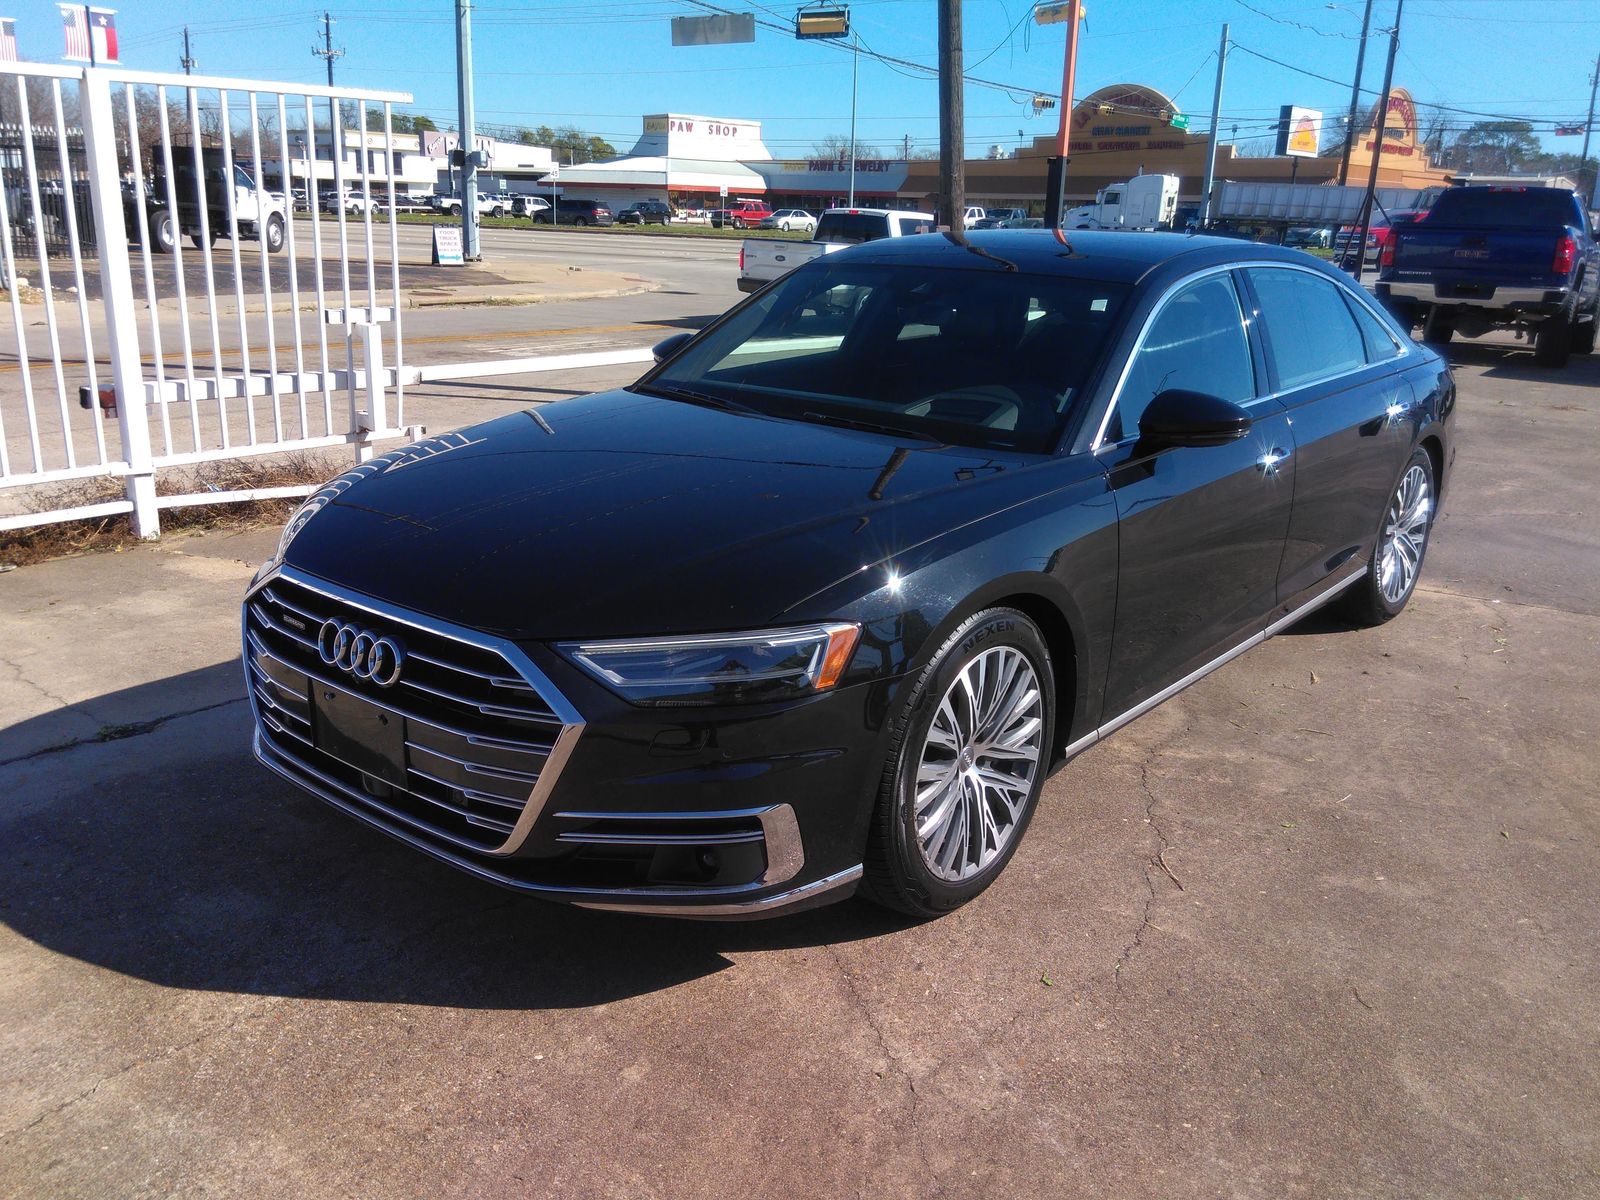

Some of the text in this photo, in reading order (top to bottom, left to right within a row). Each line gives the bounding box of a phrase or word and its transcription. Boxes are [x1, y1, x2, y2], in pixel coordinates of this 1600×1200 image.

[670, 120, 738, 137] PAW SHOP
[808, 160, 835, 171] PAWN
[848, 160, 890, 172] EWELRY
[962, 620, 1015, 654] NEXEN
